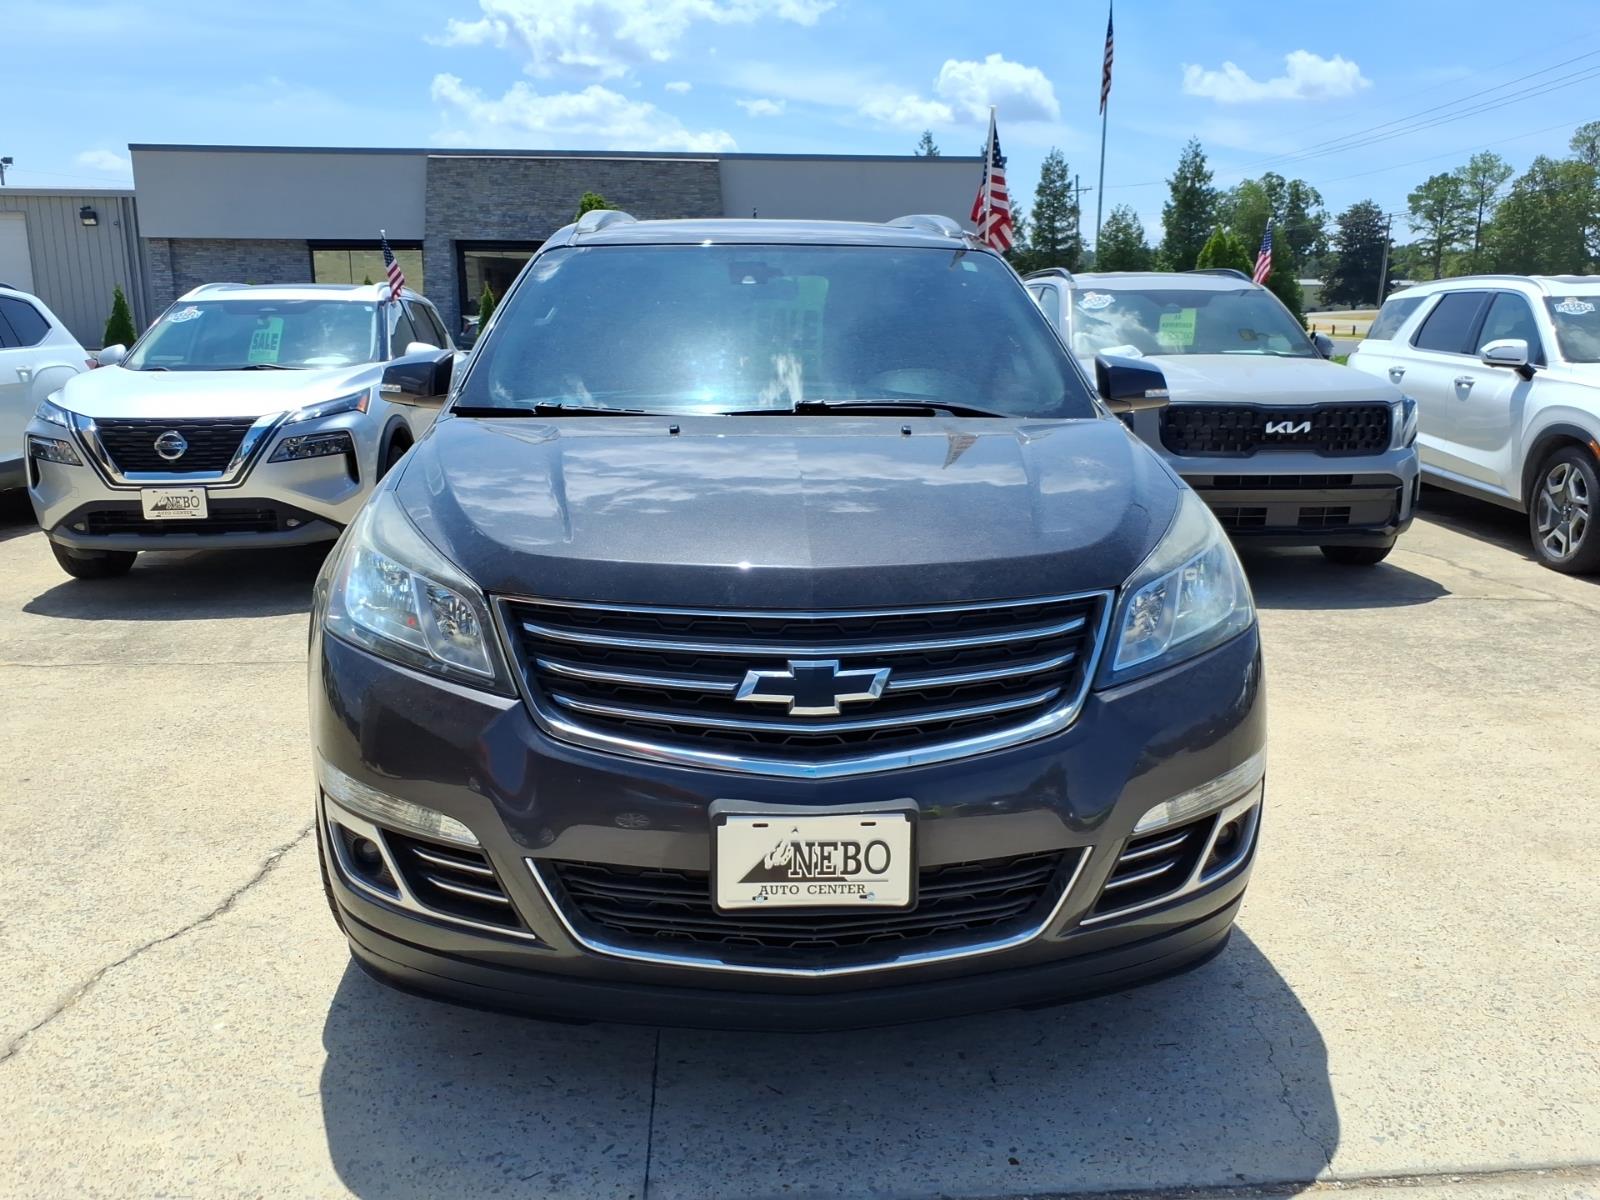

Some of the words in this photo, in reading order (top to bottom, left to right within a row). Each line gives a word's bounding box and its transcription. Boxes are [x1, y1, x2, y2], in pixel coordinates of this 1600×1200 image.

[1265, 421, 1311, 433] KIA
[166, 496, 200, 509] NEBO
[789, 840, 891, 876] NEBO
[759, 885, 799, 895] AUTO
[807, 884, 866, 895] CENTER
